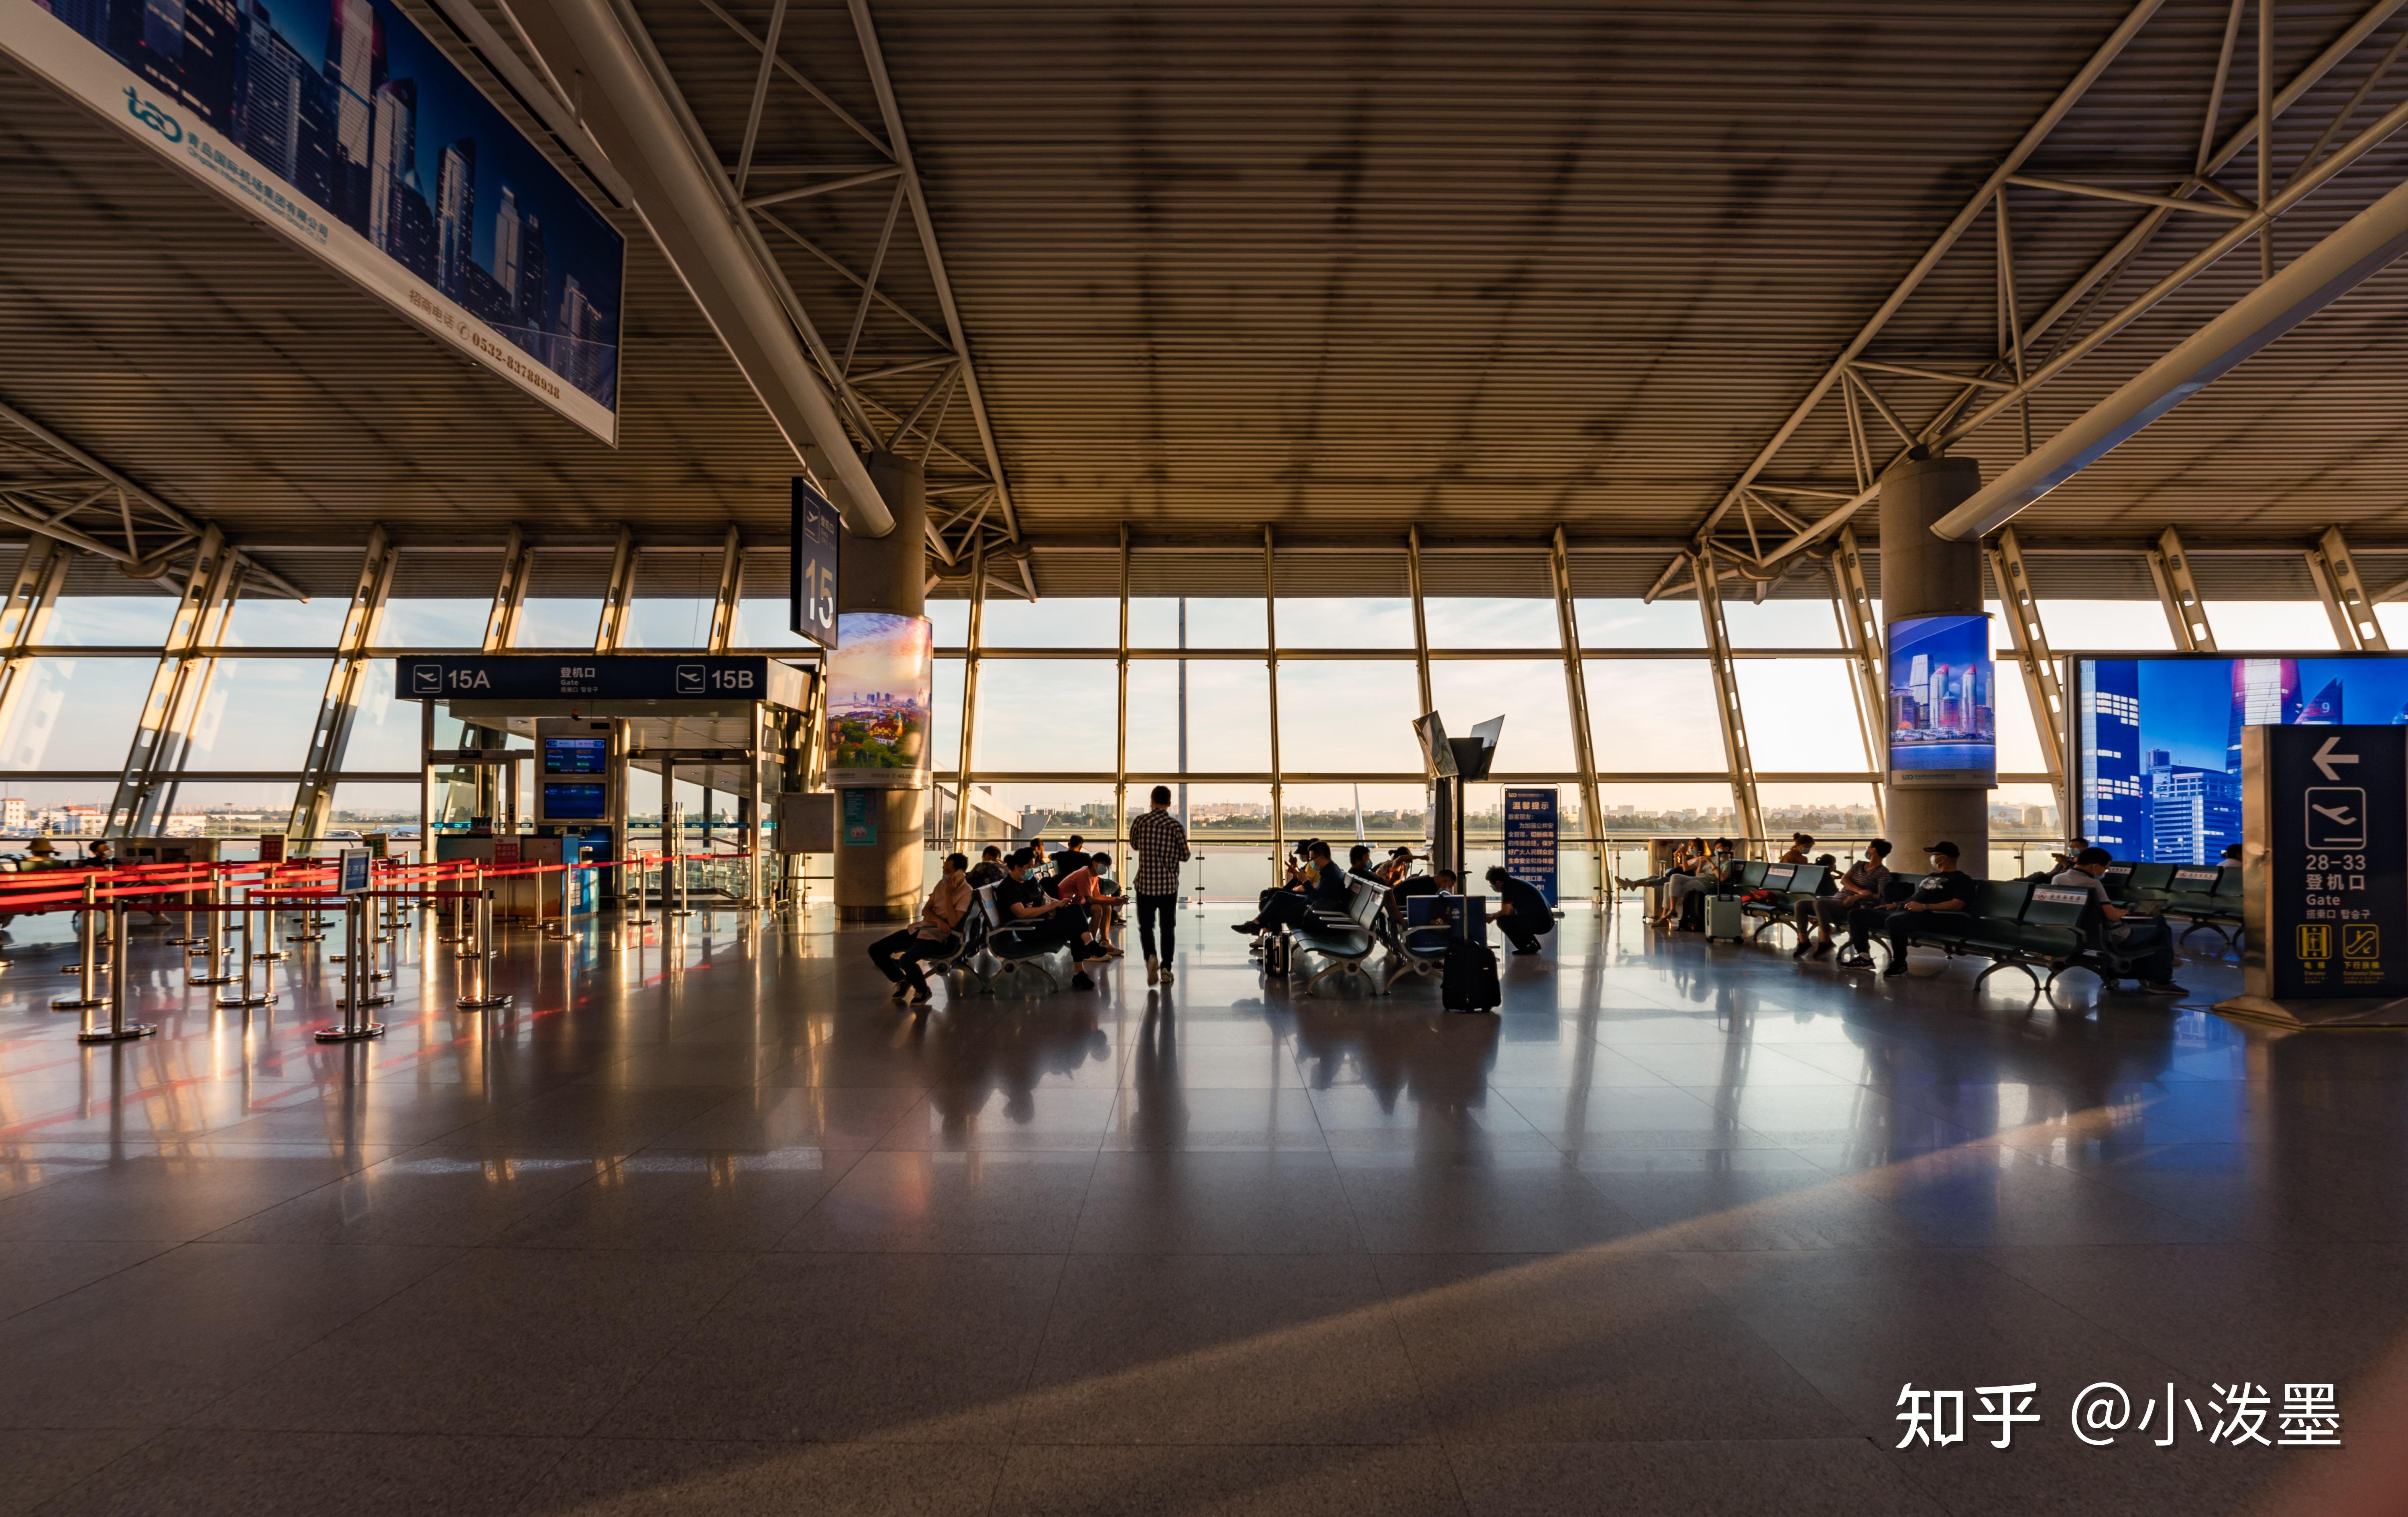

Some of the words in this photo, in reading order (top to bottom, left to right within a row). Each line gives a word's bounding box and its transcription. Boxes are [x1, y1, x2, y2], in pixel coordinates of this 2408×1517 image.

[187, 131, 328, 238] 青岛国际机场集团有限公司
[408, 289, 454, 330] 招商电话
[472, 332, 560, 400] 0532-83788938
[821, 515, 834, 535] 登机口
[805, 558, 834, 629] 15
[448, 670, 491, 688] 15A
[560, 667, 595, 678] 登机口
[712, 670, 753, 689] 15B
[1512, 801, 1549, 809] 温馨提示
[2306, 854, 2366, 870] 28-33
[2306, 873, 2365, 891] 登机口
[2306, 894, 2341, 905] Gate
[2340, 909, 2371, 919] 탑승구
[2304, 962, 2325, 970] 电梯
[2344, 962, 2380, 970] 下行扶梯
